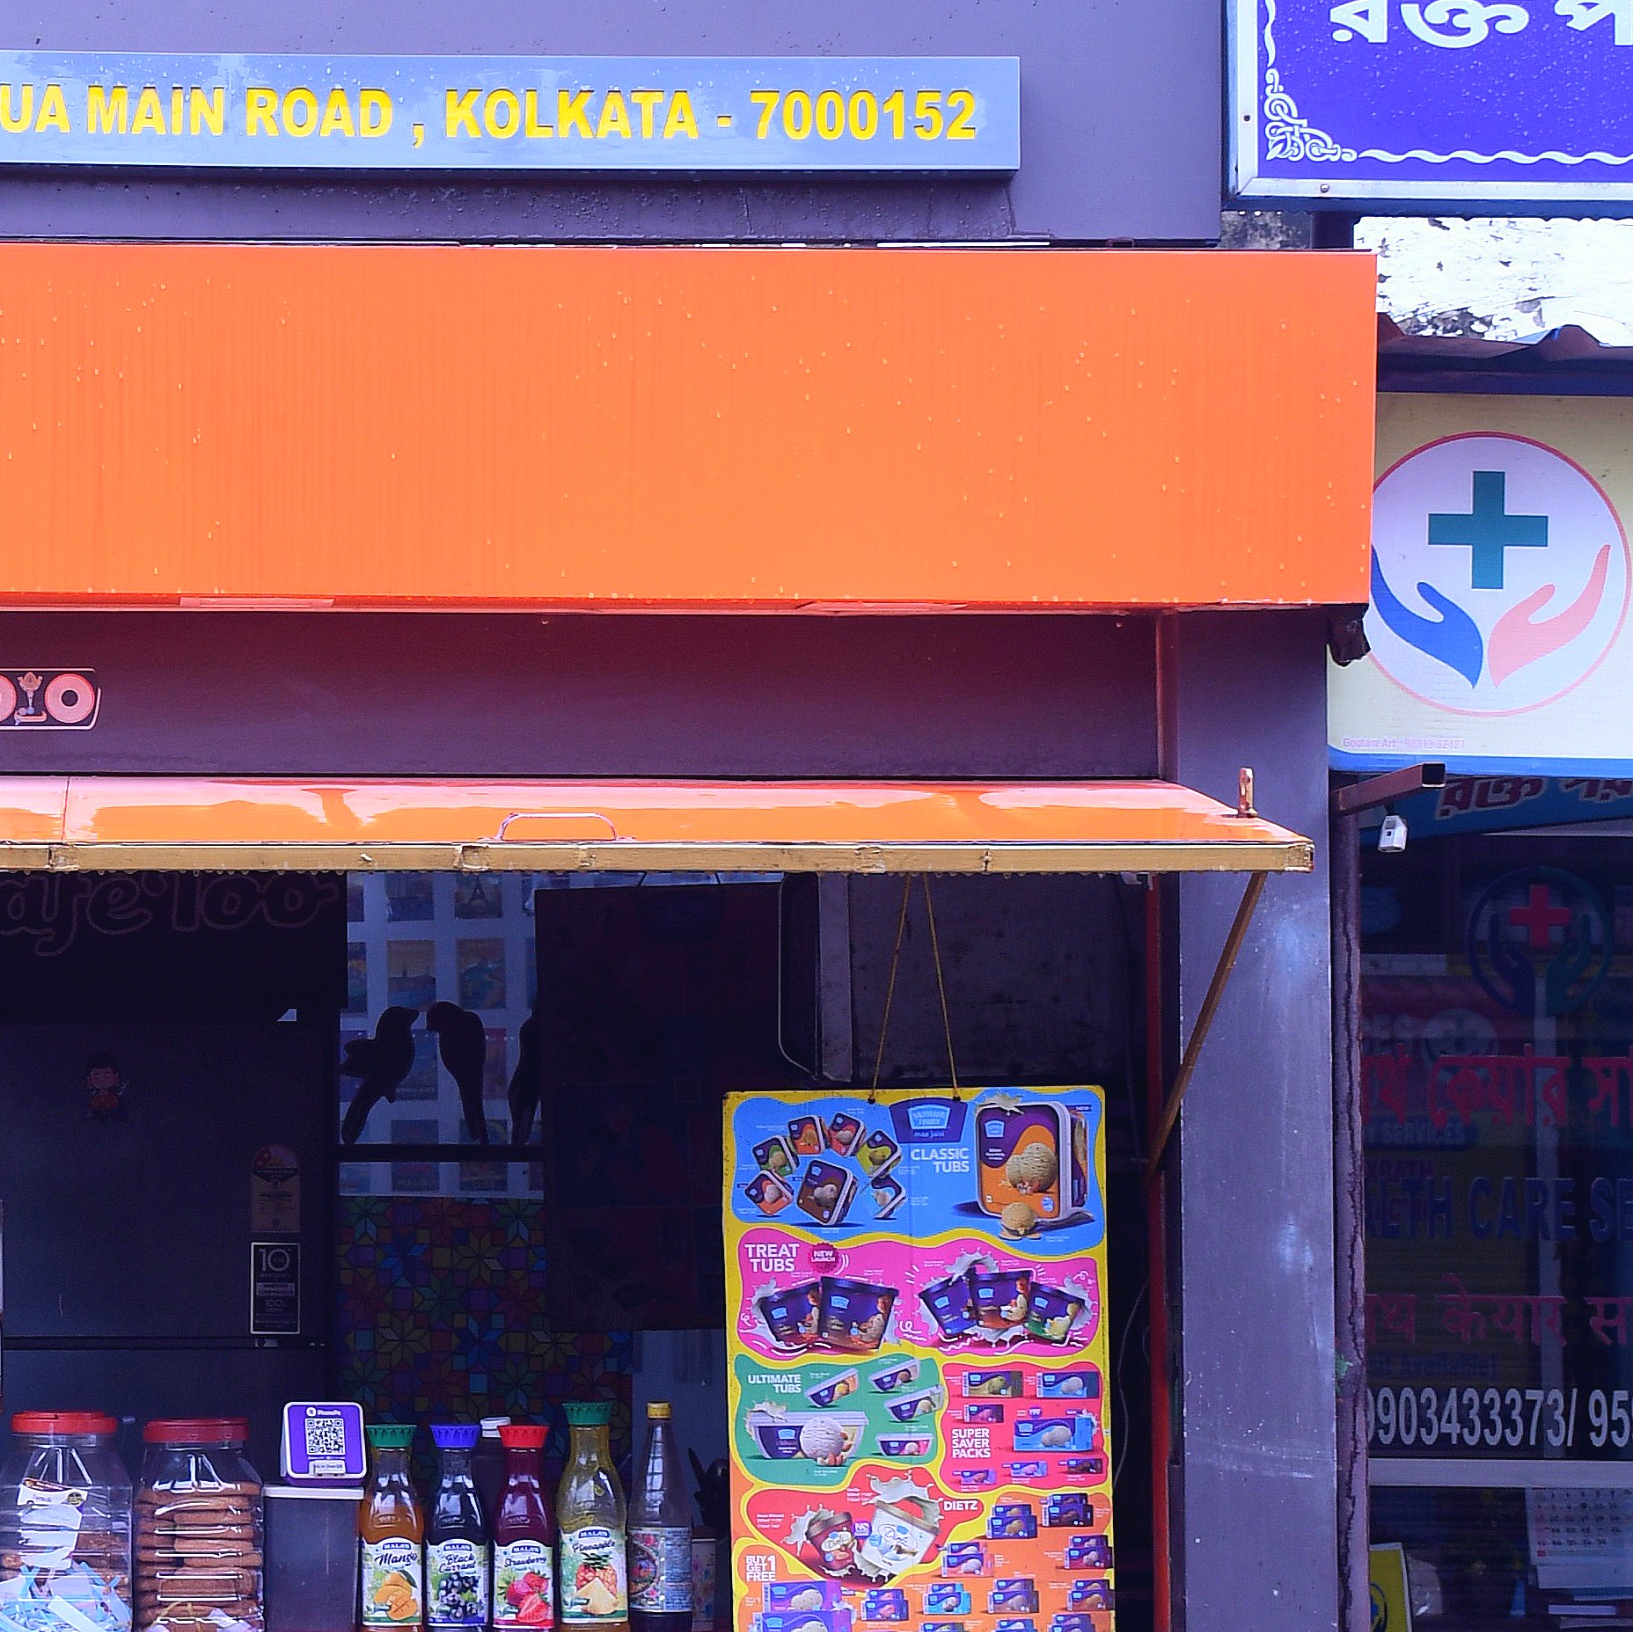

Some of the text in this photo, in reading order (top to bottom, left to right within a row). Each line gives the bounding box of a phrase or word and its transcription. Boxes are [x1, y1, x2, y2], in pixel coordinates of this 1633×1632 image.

[87, 85, 224, 135] MAIN
[245, 87, 393, 137] ROAD
[445, 88, 700, 139] KOLKATA
[749, 90, 976, 141] 7000152
[910, 1148, 970, 1161] CLASSIC
[933, 1161, 970, 1173] TUBS
[1467, 1175, 1578, 1243] CARE
[744, 1243, 800, 1258] TREAT
[750, 1258, 796, 1273] TUBS
[747, 1374, 802, 1384] ULTIMATE
[772, 1383, 802, 1394] TUBS
[951, 1428, 990, 1439] SUPER
[951, 1438, 990, 1448] SAVER
[952, 1448, 991, 1459] PACKS
[943, 1500, 978, 1511] DIETZ
[745, 1555, 766, 1565] BUY
[746, 1564, 767, 1573] GET
[746, 1572, 776, 1582] FREE
